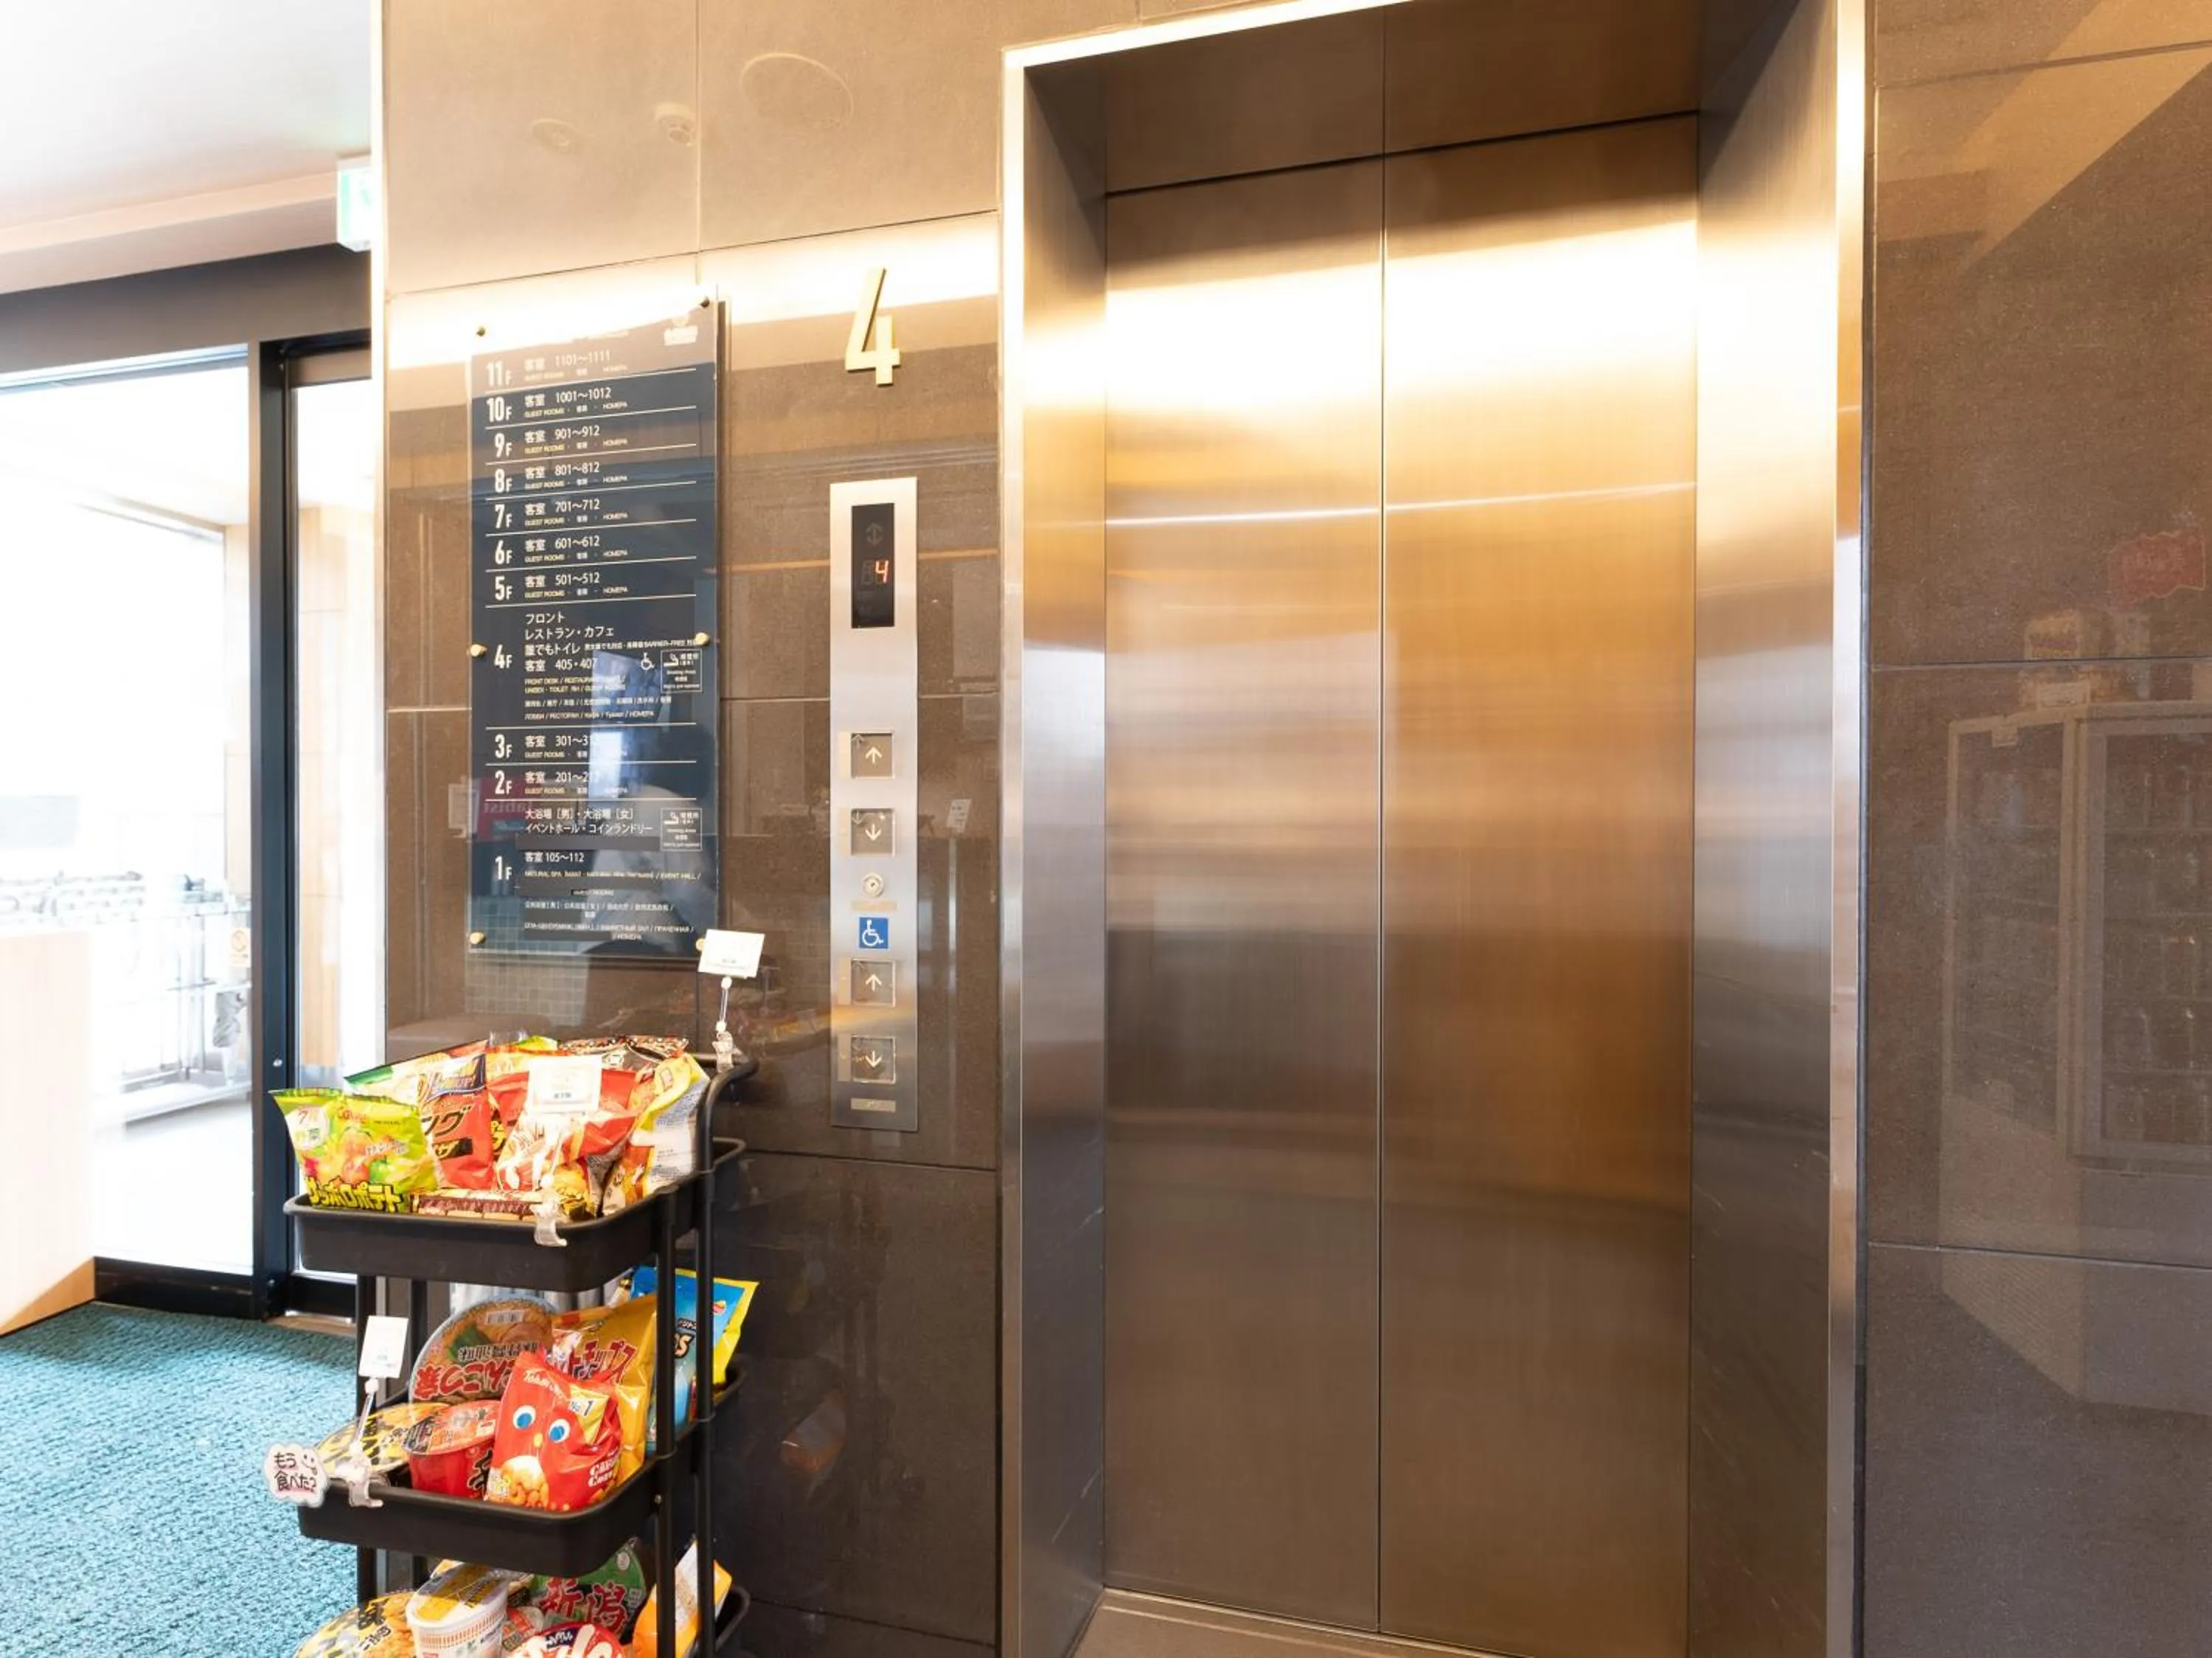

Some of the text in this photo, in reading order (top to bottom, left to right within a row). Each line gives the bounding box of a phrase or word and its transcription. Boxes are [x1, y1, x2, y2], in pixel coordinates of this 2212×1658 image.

[846, 268, 901, 385] 4
[875, 560, 889, 583] 4
[525, 611, 566, 625] フロント
[525, 626, 614, 640] レストラン・カフェ
[274, 1452, 297, 1468] もう
